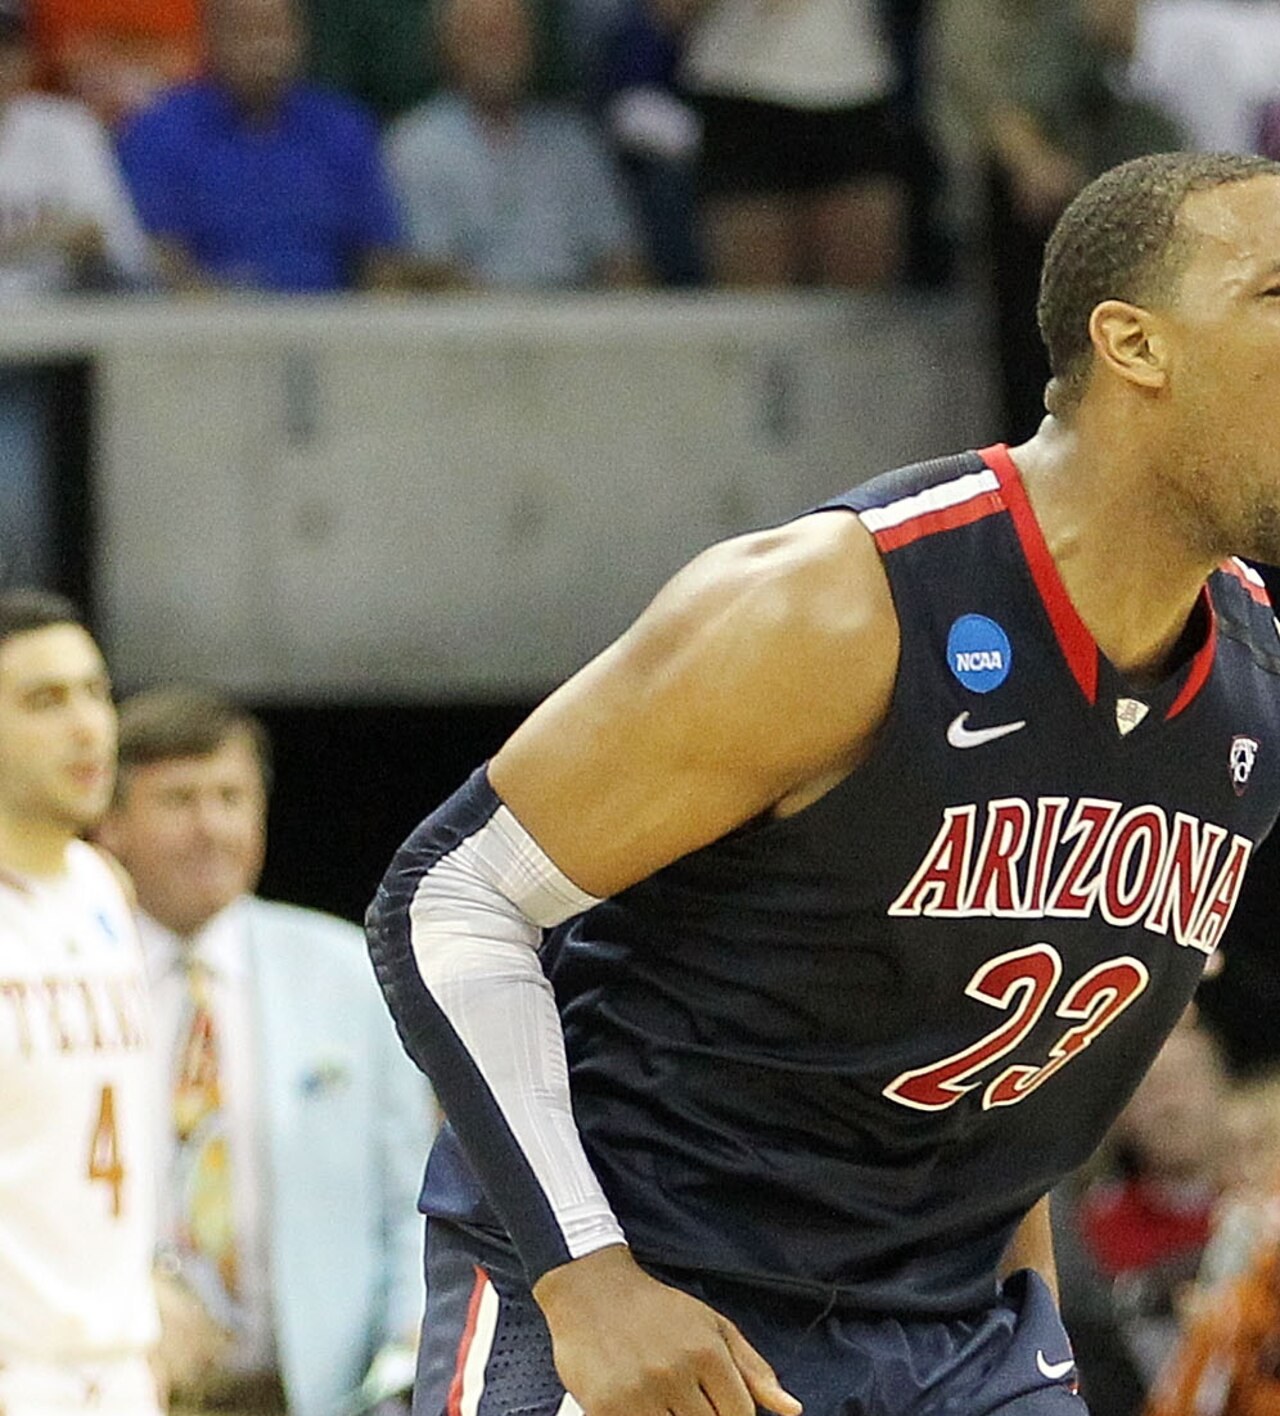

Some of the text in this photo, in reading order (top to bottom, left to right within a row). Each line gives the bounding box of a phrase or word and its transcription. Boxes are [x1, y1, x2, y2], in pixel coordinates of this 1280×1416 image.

[956, 650, 1002, 672] NCAA
[887, 797, 1254, 955] ARIZONA
[882, 943, 1150, 1111] 23
[87, 1085, 125, 1216] 4
